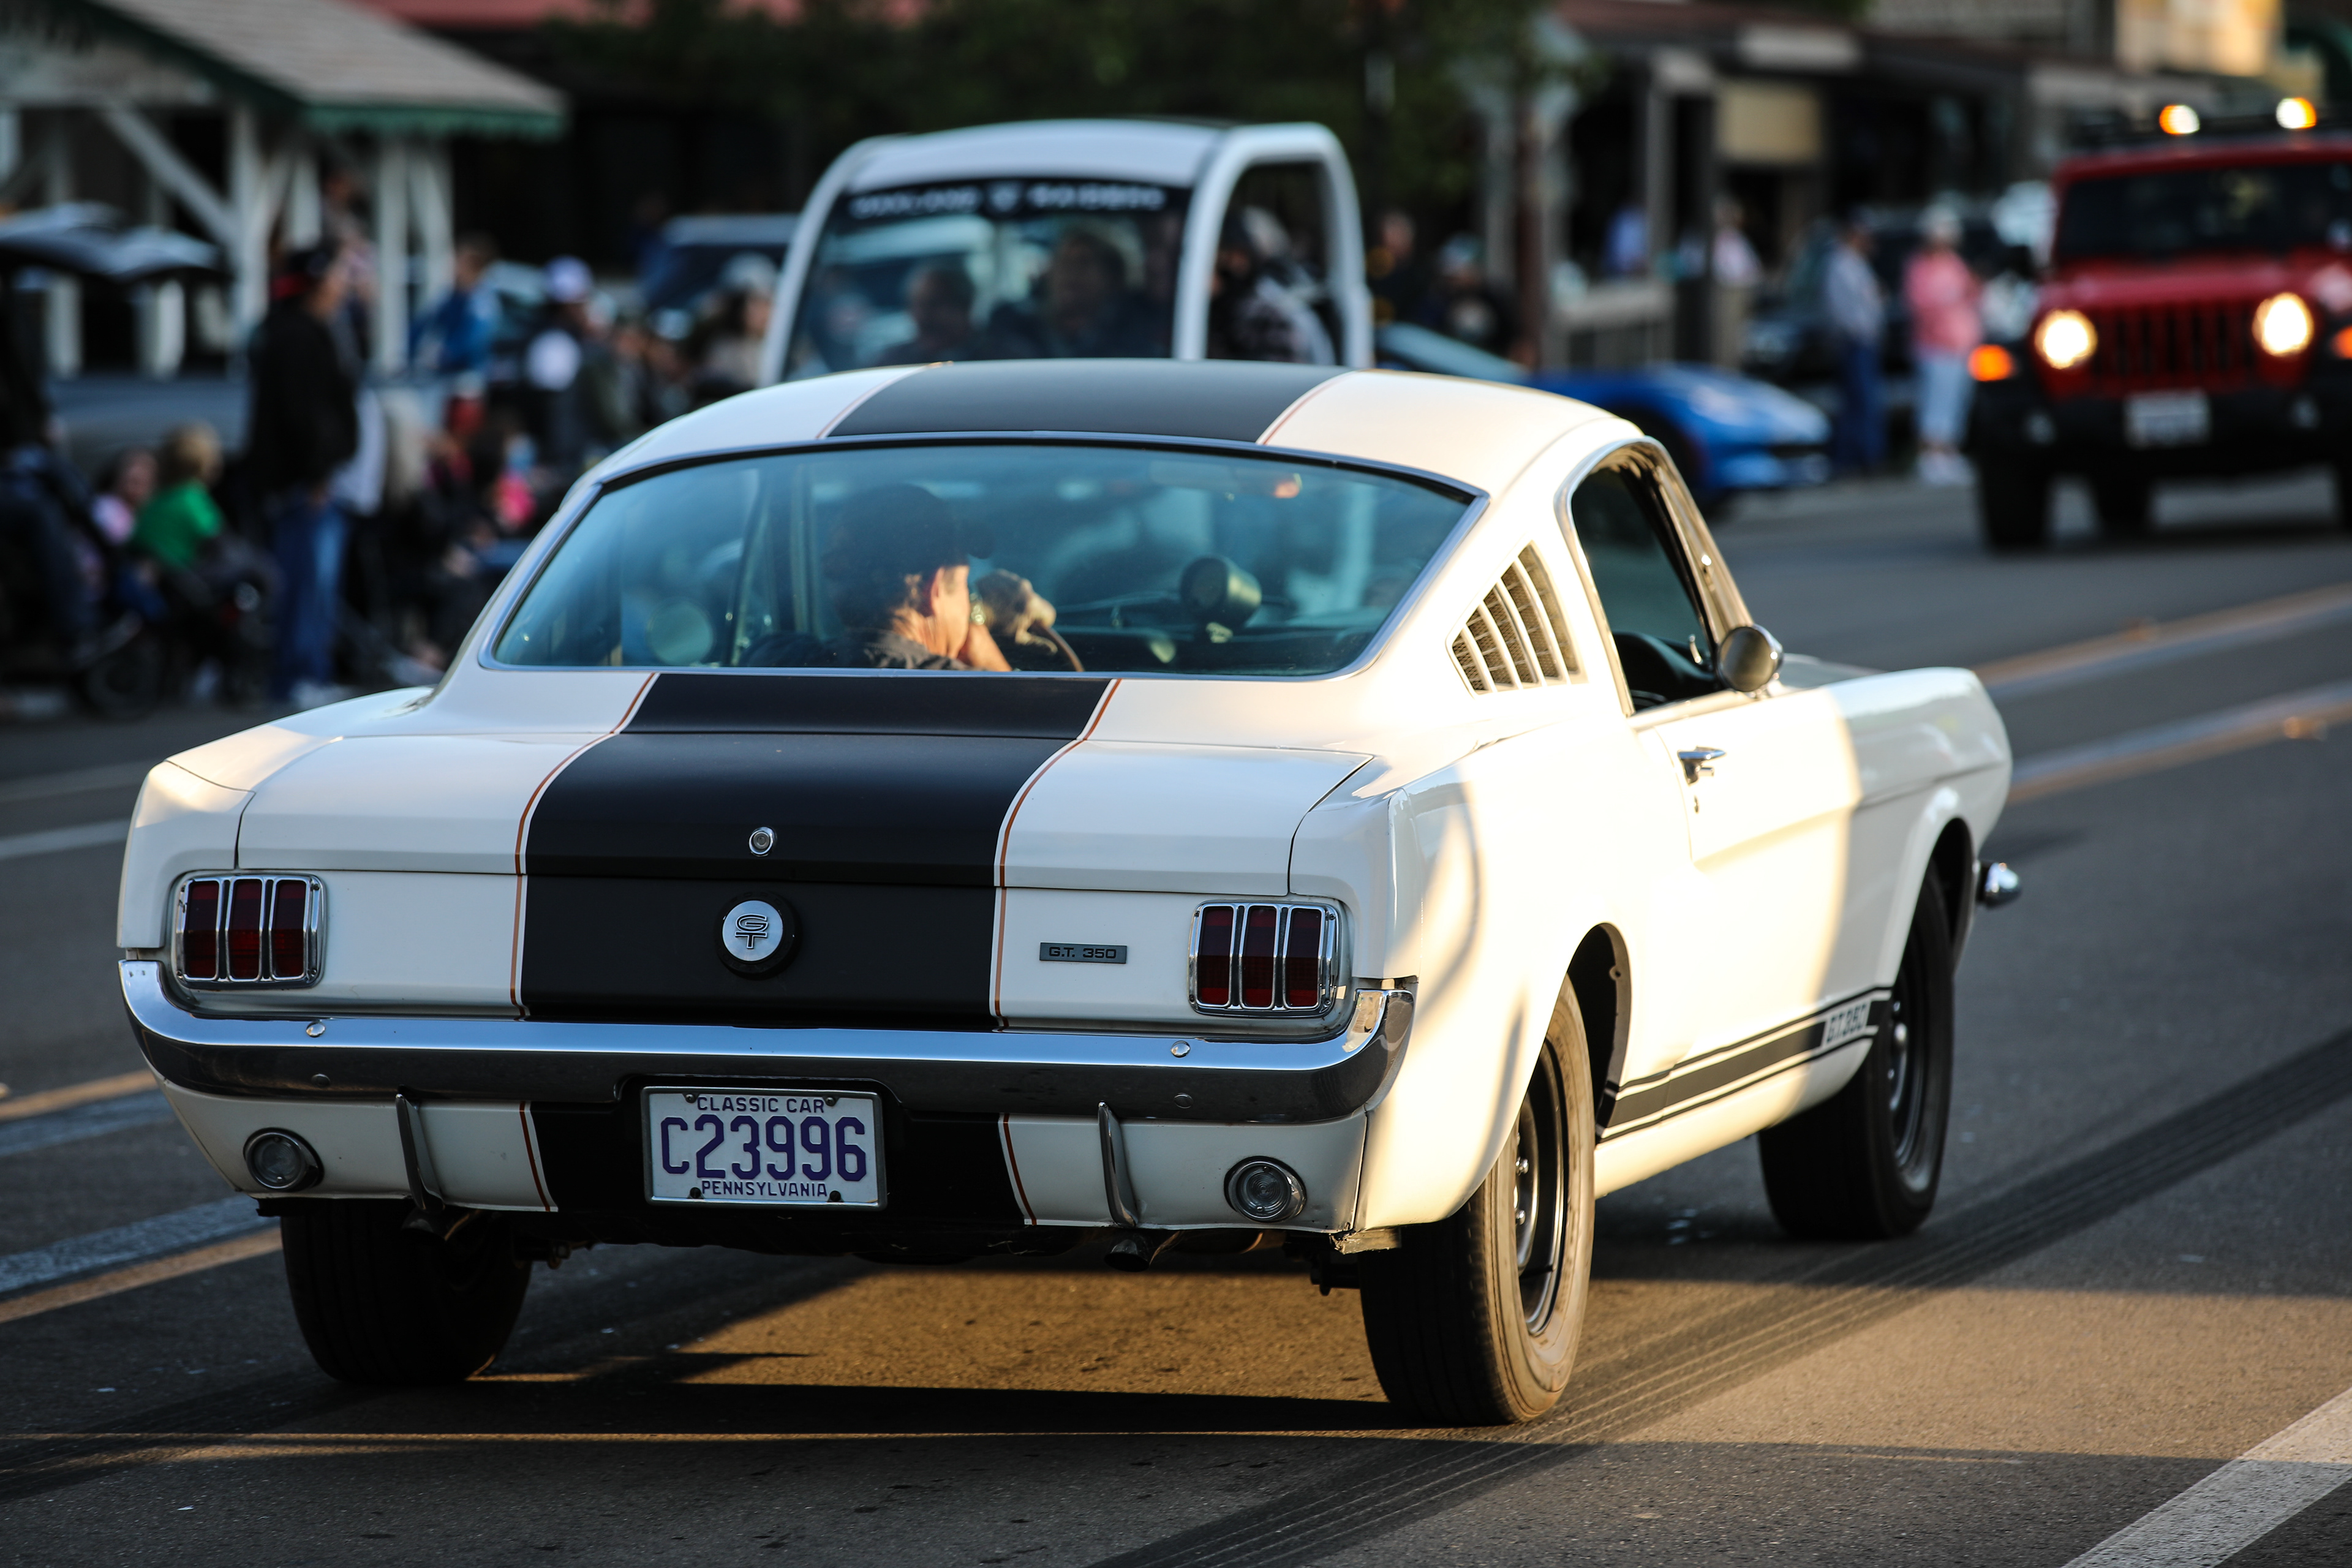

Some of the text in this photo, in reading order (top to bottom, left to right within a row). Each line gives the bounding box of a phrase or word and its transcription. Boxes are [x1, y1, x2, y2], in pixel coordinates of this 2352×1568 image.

[1049, 946, 1117, 959] G.T. 350
[697, 1097, 824, 1114] CLASSIC CAR
[660, 1114, 867, 1182] C23996
[701, 1180, 827, 1197] PENNSYLVANIA
